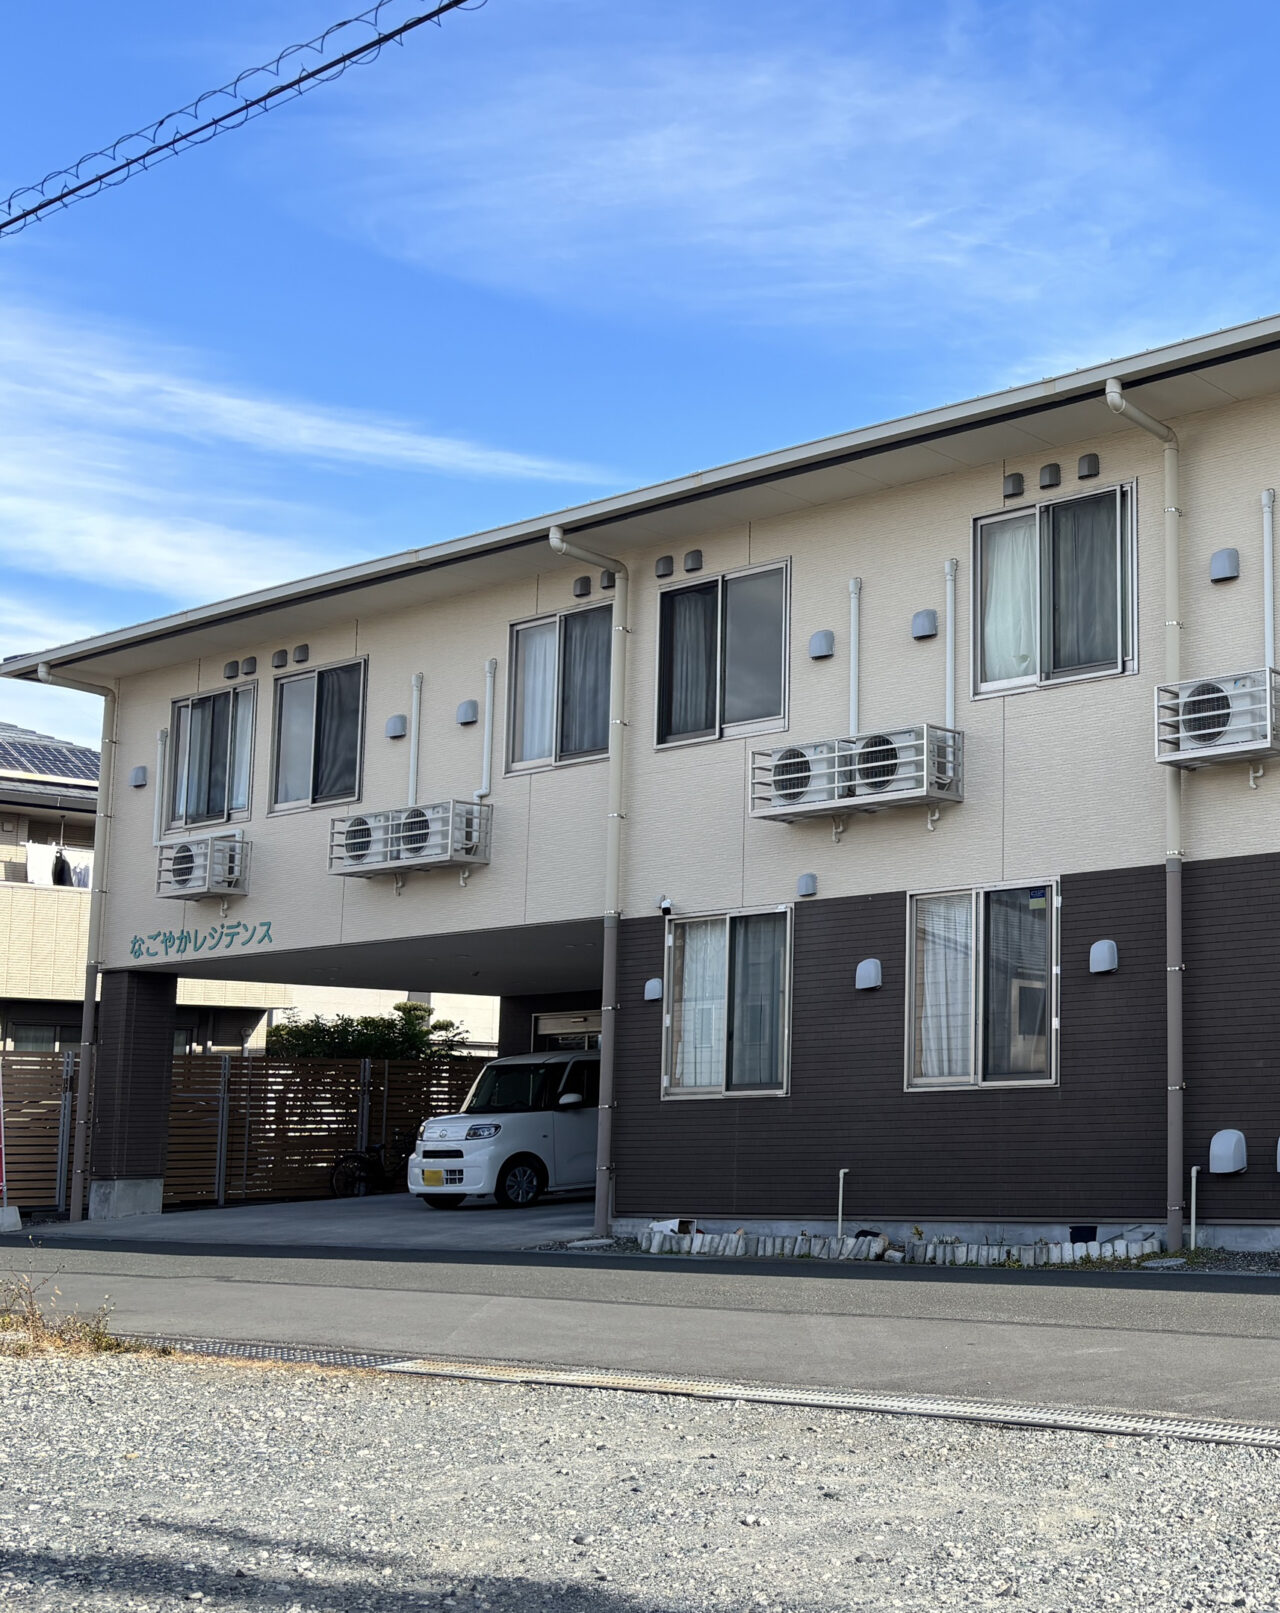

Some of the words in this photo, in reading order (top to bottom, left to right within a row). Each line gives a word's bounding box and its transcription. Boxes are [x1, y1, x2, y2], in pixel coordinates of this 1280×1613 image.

[130, 921, 273, 959] なごやかレジデンス
